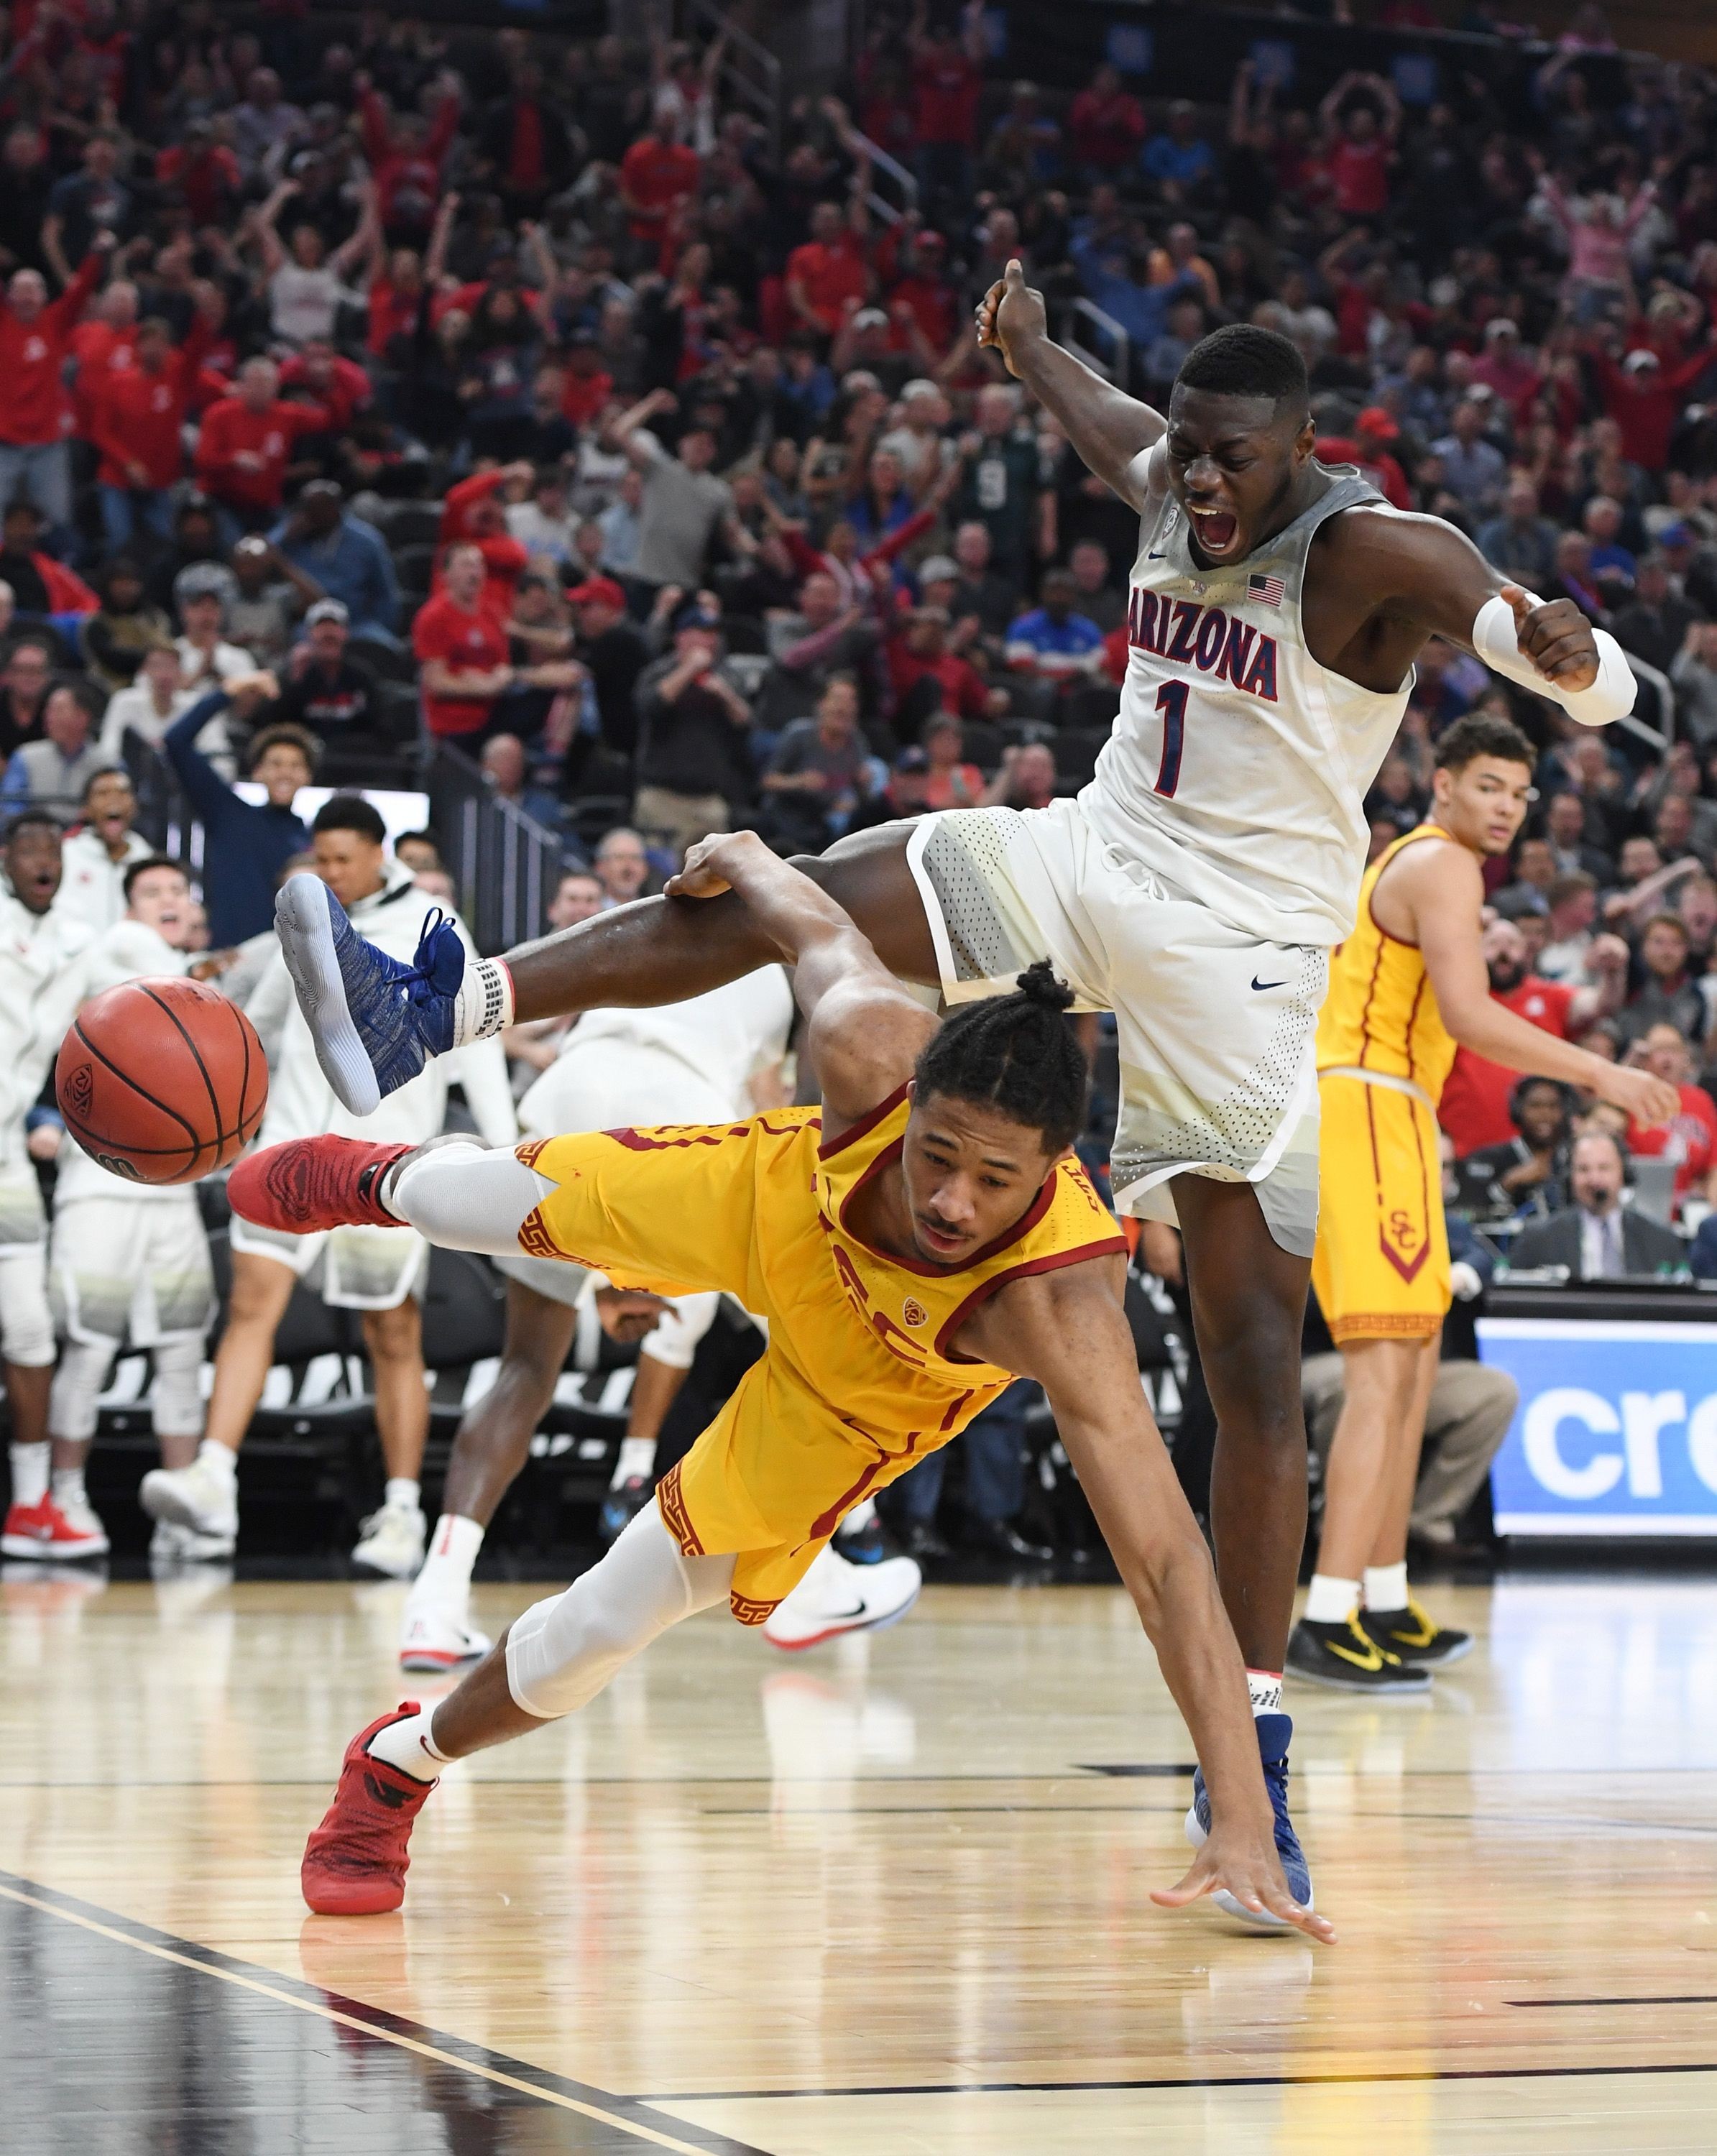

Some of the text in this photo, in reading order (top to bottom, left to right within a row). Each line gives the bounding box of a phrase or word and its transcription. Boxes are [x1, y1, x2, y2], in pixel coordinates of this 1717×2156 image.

[1128, 587, 1278, 702] ARIZONA
[1154, 679, 1190, 798] 1
[1522, 1386, 1717, 1501] cr
